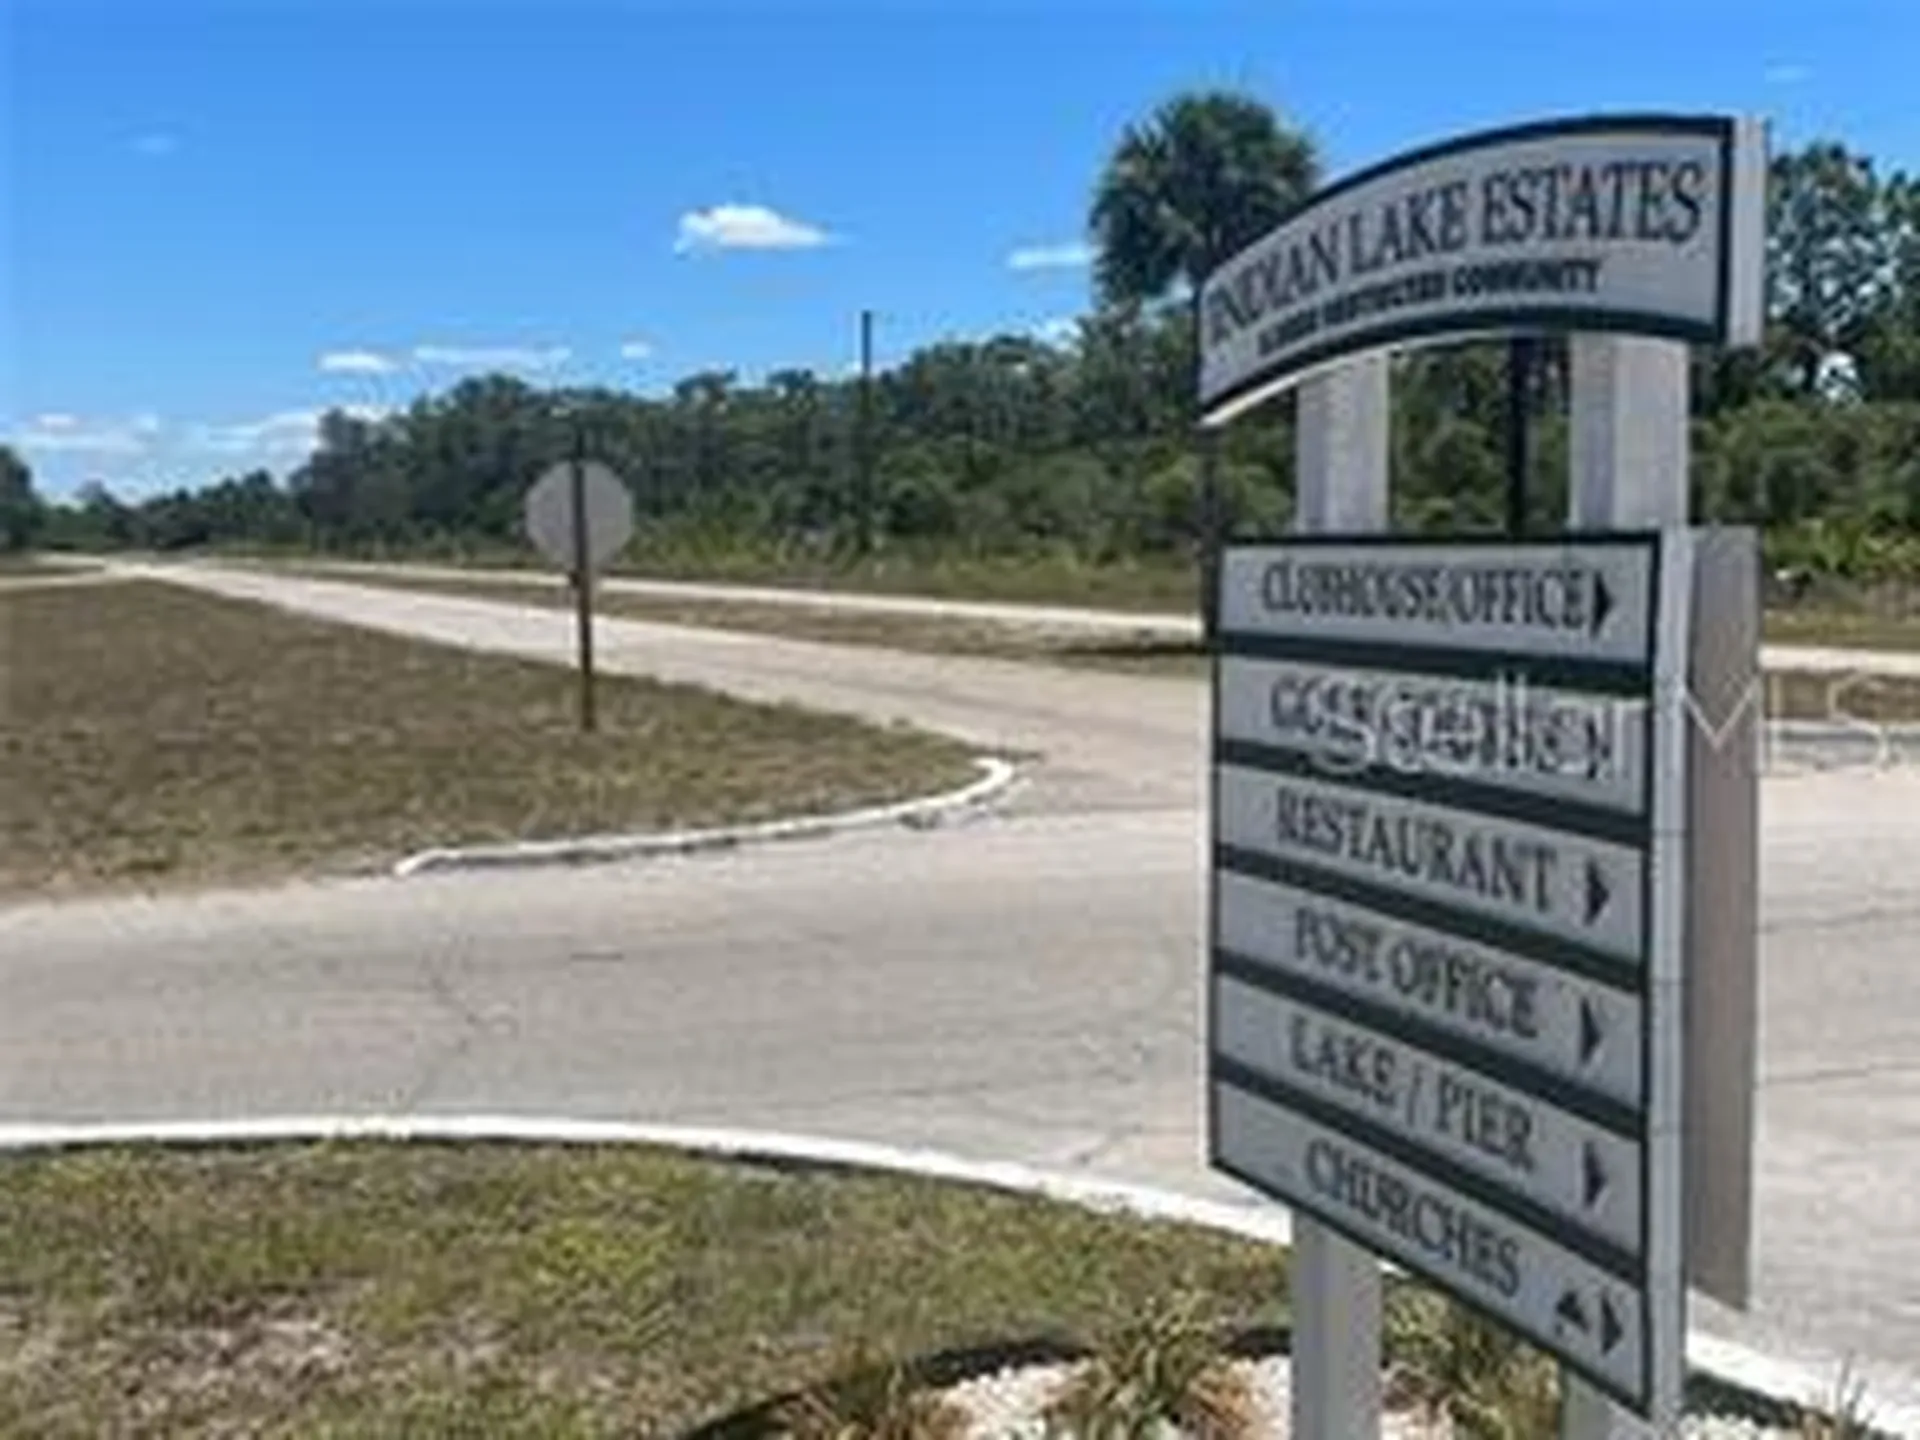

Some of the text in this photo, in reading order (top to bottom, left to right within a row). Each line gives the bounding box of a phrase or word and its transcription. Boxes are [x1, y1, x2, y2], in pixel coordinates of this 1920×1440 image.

[1206, 220, 1340, 346] INDIAN
[1350, 180, 1468, 273] LAKE
[1482, 159, 1704, 244] ESTATES
[1453, 258, 1600, 297] COMMUNITY
[1275, 786, 1557, 914] RESTAURANT
[1295, 904, 1540, 1040] POST OFFICE
[1288, 1010, 1398, 1104] LAKE
[1436, 1074, 1535, 1174] PIER
[1305, 1136, 1522, 1300] CHURCHES
